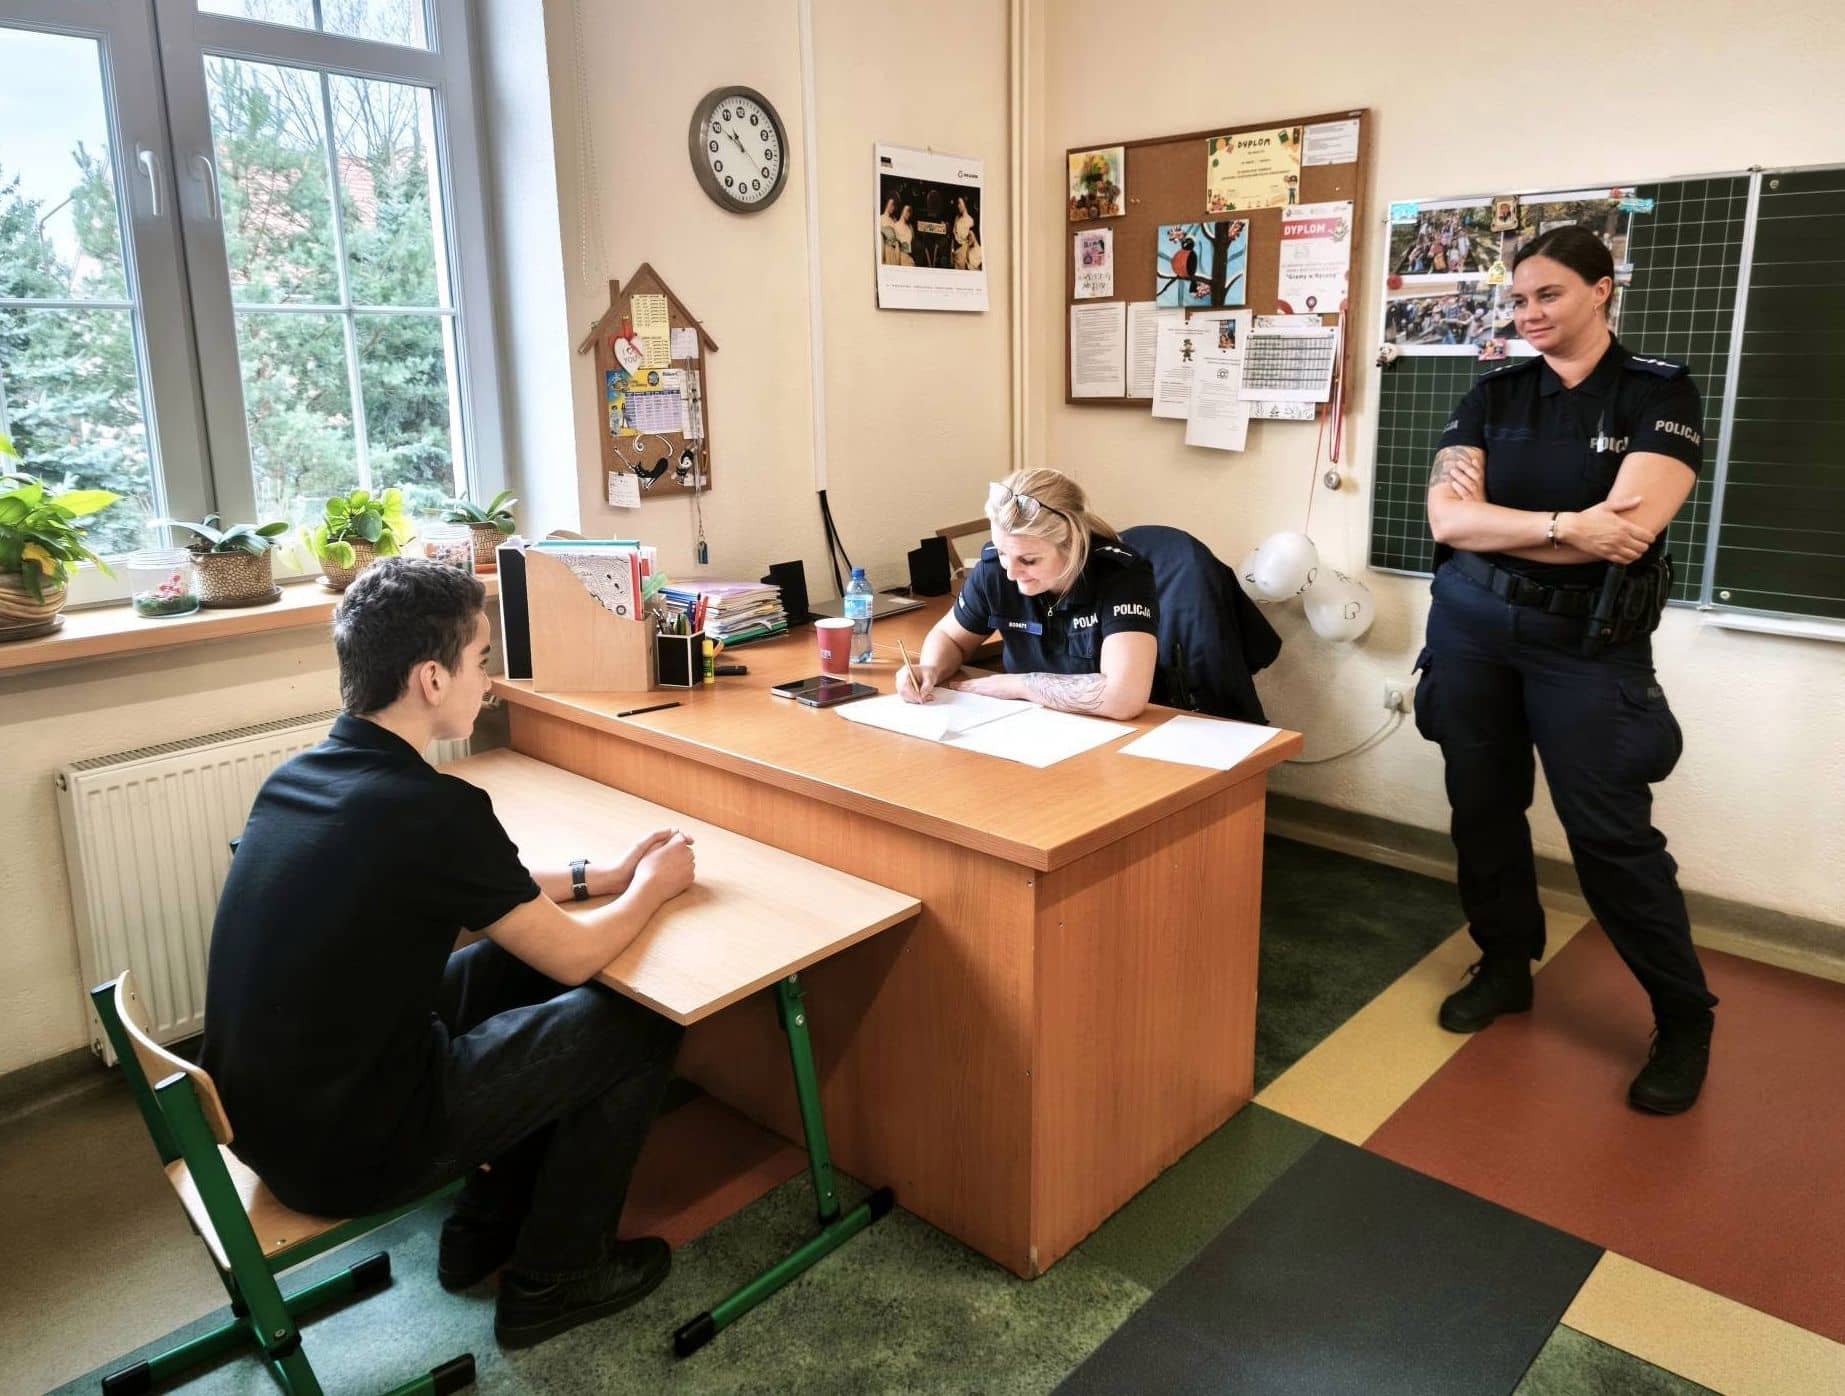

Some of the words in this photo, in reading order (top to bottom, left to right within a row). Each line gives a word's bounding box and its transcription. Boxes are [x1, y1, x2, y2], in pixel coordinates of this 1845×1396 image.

[1237, 138, 1271, 149] DYPLOM
[1284, 224, 1325, 236] DYPLOM
[1655, 420, 1701, 446] POLICJA
[1113, 603, 1151, 619] POLICJA
